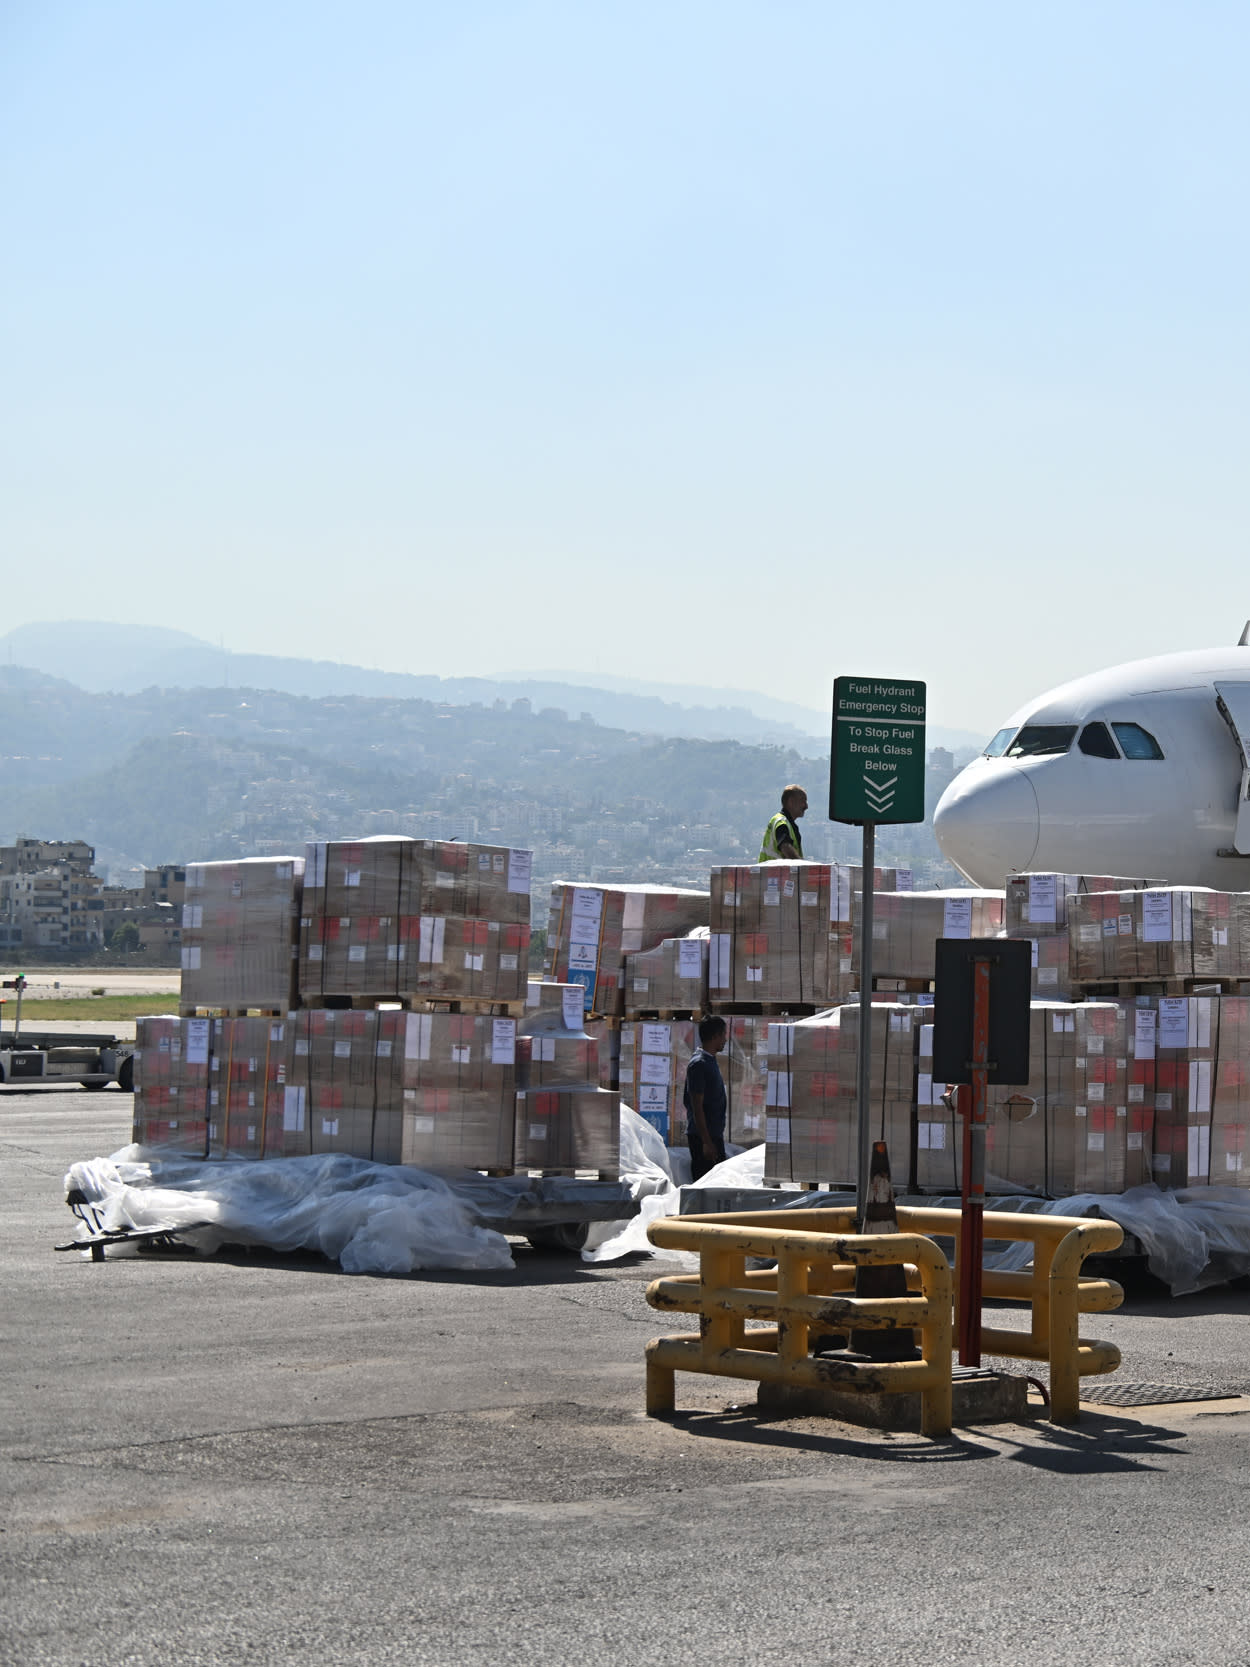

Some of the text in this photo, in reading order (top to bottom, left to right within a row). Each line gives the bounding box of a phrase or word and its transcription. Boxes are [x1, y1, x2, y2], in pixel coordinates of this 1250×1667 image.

[849, 683, 915, 697] Fuel Hydrant
[839, 700, 924, 716] Emergency Stop
[849, 727, 914, 739] To Stop Fuel
[850, 743, 913, 756] Break Glass
[865, 760, 897, 771] Below
